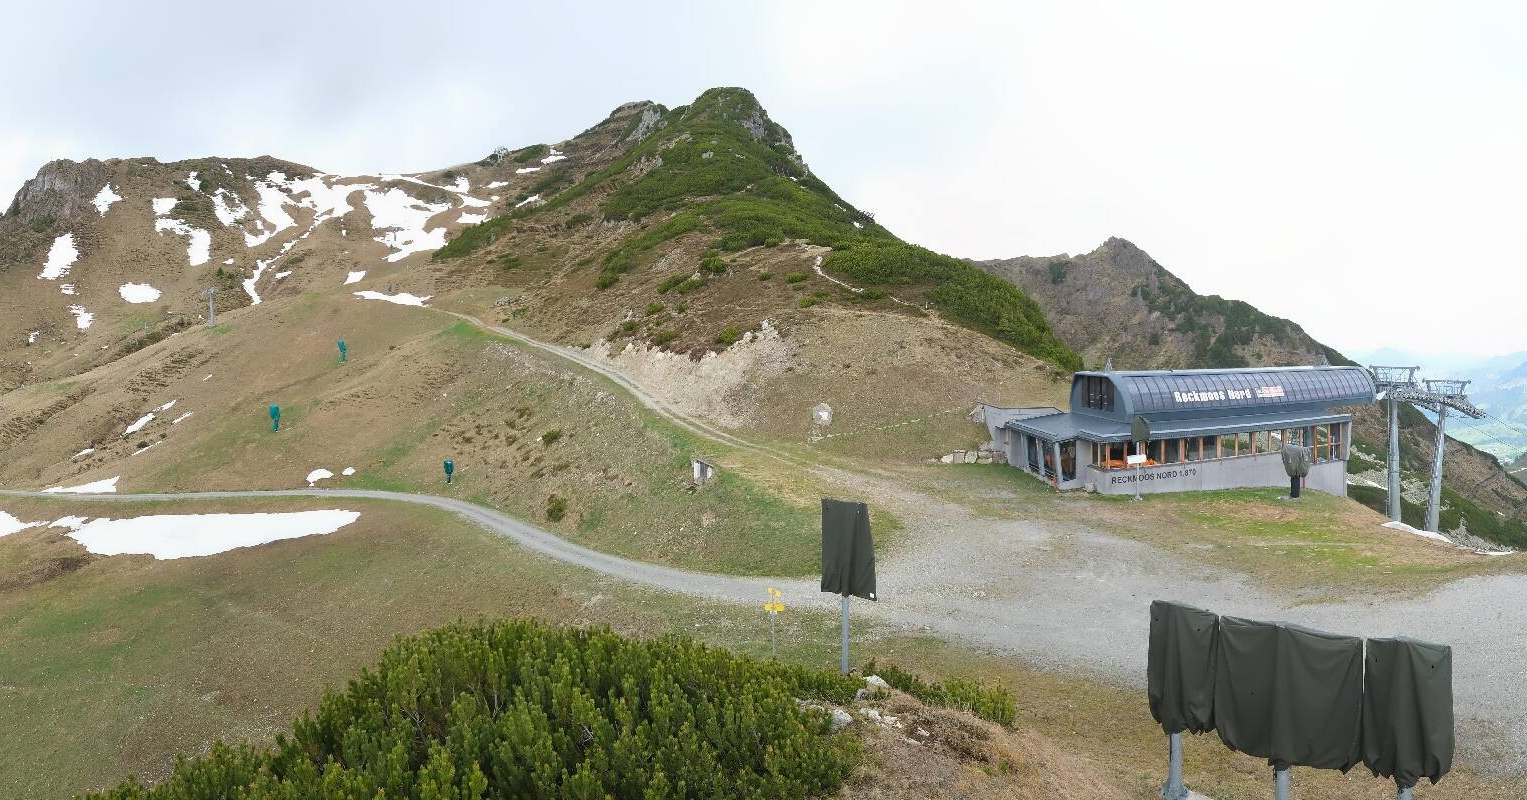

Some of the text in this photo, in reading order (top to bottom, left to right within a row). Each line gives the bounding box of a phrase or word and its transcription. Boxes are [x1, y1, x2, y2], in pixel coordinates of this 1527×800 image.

[1173, 390, 1226, 403] Reckmoos
[1226, 388, 1252, 400] Nord
[1156, 470, 1178, 480] NORD
